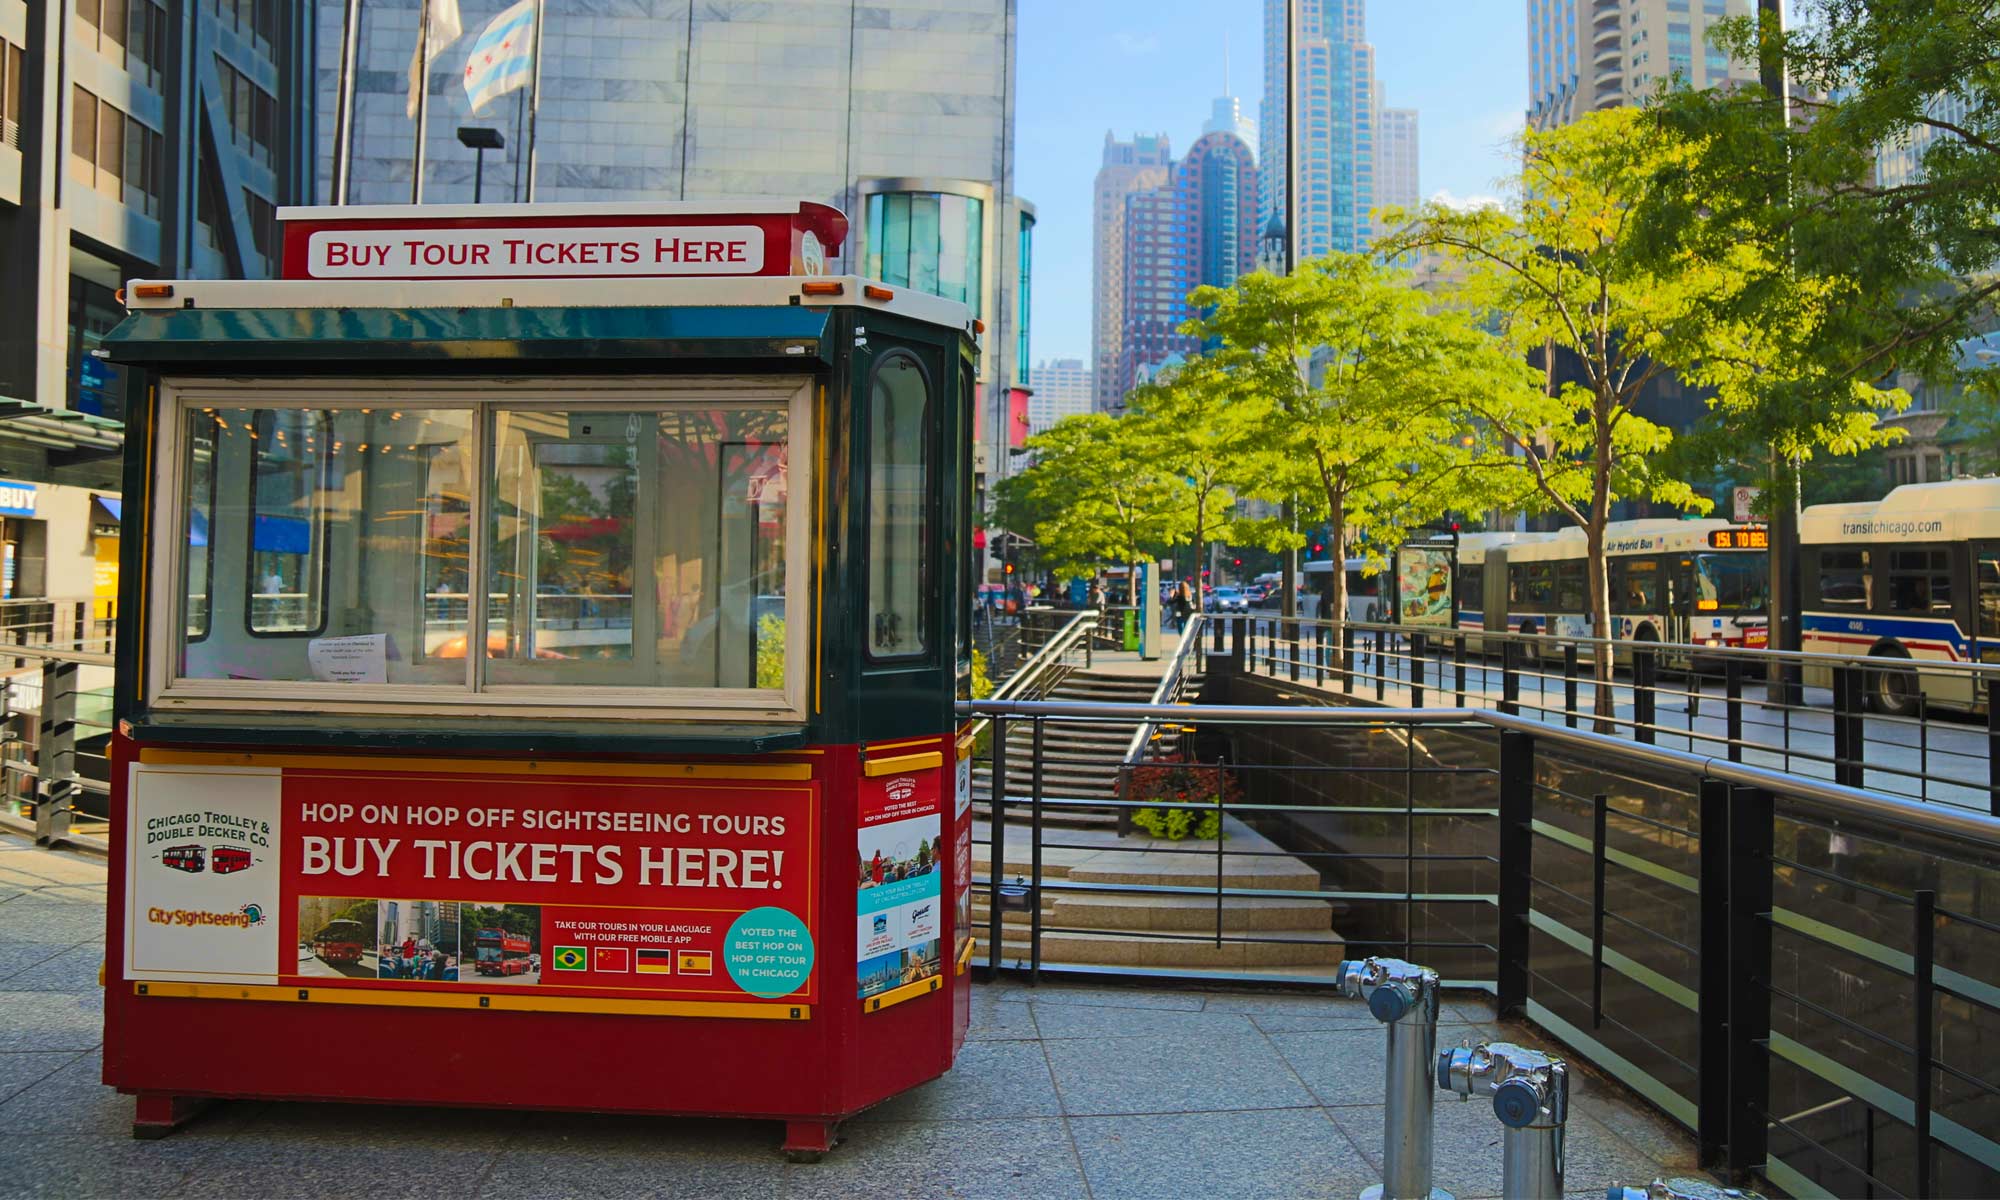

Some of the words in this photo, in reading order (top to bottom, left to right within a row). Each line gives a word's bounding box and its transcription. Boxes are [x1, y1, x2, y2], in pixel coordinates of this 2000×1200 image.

[326, 242, 392, 266] BUY
[403, 241, 490, 265] TOUR
[503, 240, 640, 264] TICKETS
[655, 238, 747, 263] HERE
[0, 487, 37, 510] BUY
[1843, 520, 1942, 537] transitchicago.com
[1607, 541, 1615, 550] Air
[1617, 539, 1639, 552] Hybrid
[1640, 539, 1653, 549] Bus
[1715, 532, 1731, 547] 151
[1736, 532, 1749, 547] TO
[147, 813, 201, 830] CHICAGO
[204, 812, 257, 831] TROLLEY
[260, 822, 270, 834] &
[302, 803, 353, 823] HOP
[361, 804, 399, 824] ON
[407, 806, 460, 826] HOP
[466, 808, 515, 828] OFF
[522, 809, 691, 834] SIGHTSEEING
[698, 814, 785, 835] TOURS
[147, 827, 194, 844] DOUBLE
[198, 825, 246, 841] DECKER
[250, 832, 269, 848] CO.
[301, 836, 401, 877] BUY
[413, 839, 624, 886] TICKETS
[638, 846, 784, 890] HERE!
[555, 921, 576, 929] TAKE
[578, 922, 597, 930] OUR
[598, 922, 628, 931] TOURS
[629, 923, 638, 932] IN
[640, 924, 664, 932] YOUR
[665, 925, 712, 934] LANGUAGE
[741, 928, 775, 937] VOTED
[777, 929, 797, 938] THE
[574, 932, 596, 941] WITH
[598, 933, 616, 941] OUR
[618, 934, 639, 942] FREE
[640, 935, 673, 943] MOBILE
[674, 936, 692, 944] APP
[735, 941, 760, 950] BEST
[762, 942, 784, 951] HOP
[787, 943, 803, 951] ON
[731, 955, 753, 963] HOP
[756, 955, 776, 964] OFF
[777, 956, 806, 965] TOUR
[738, 968, 750, 976] IN
[752, 968, 799, 978] CHICAGO
